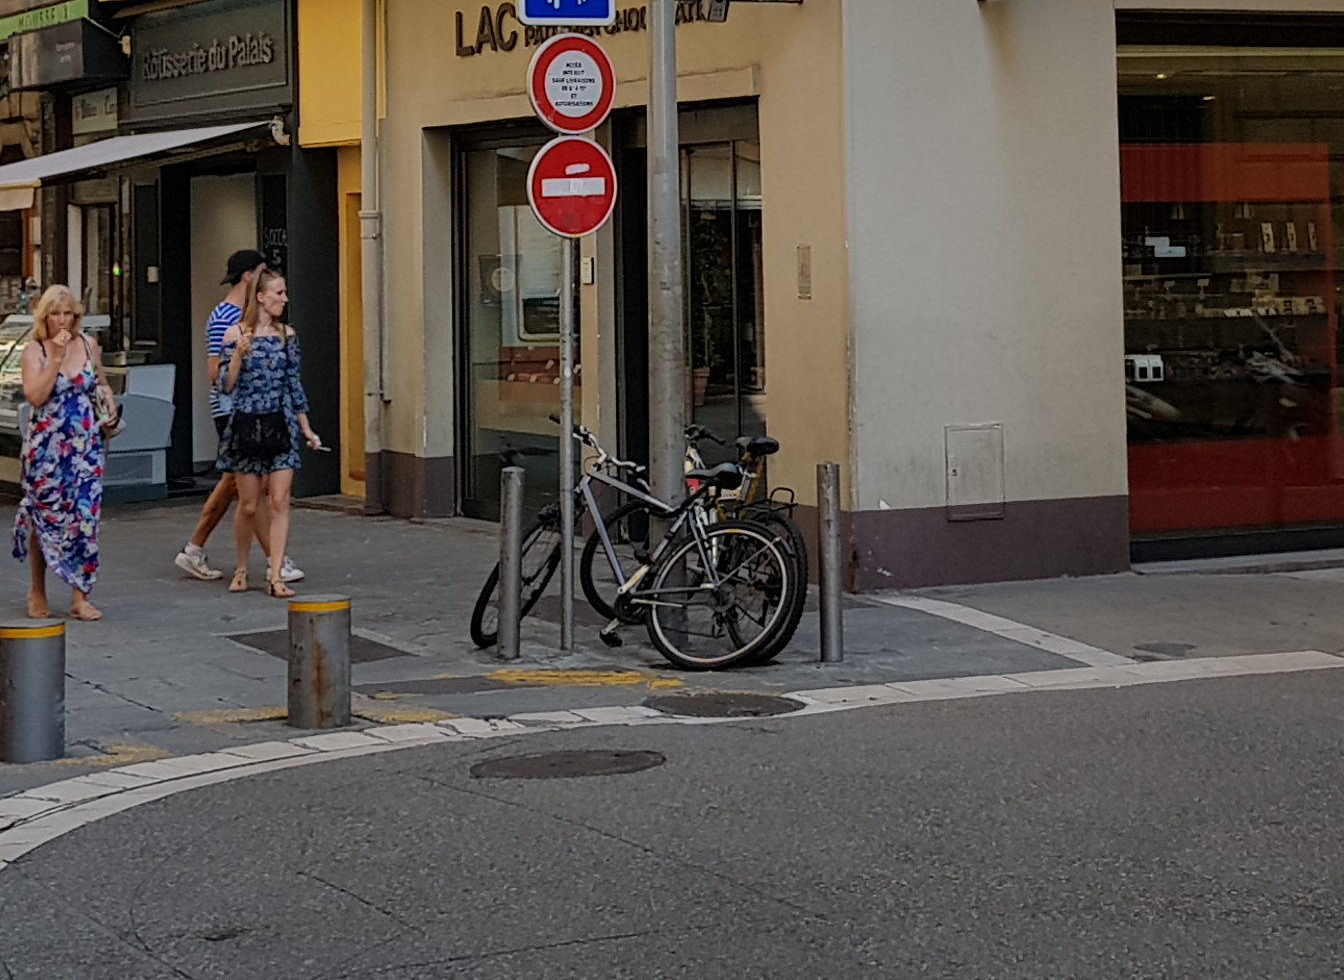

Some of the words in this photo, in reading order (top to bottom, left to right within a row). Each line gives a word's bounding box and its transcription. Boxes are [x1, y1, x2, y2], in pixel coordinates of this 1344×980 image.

[208, 38, 226, 72] du
[228, 31, 274, 69] Palais
[456, 2, 517, 56] LAC
